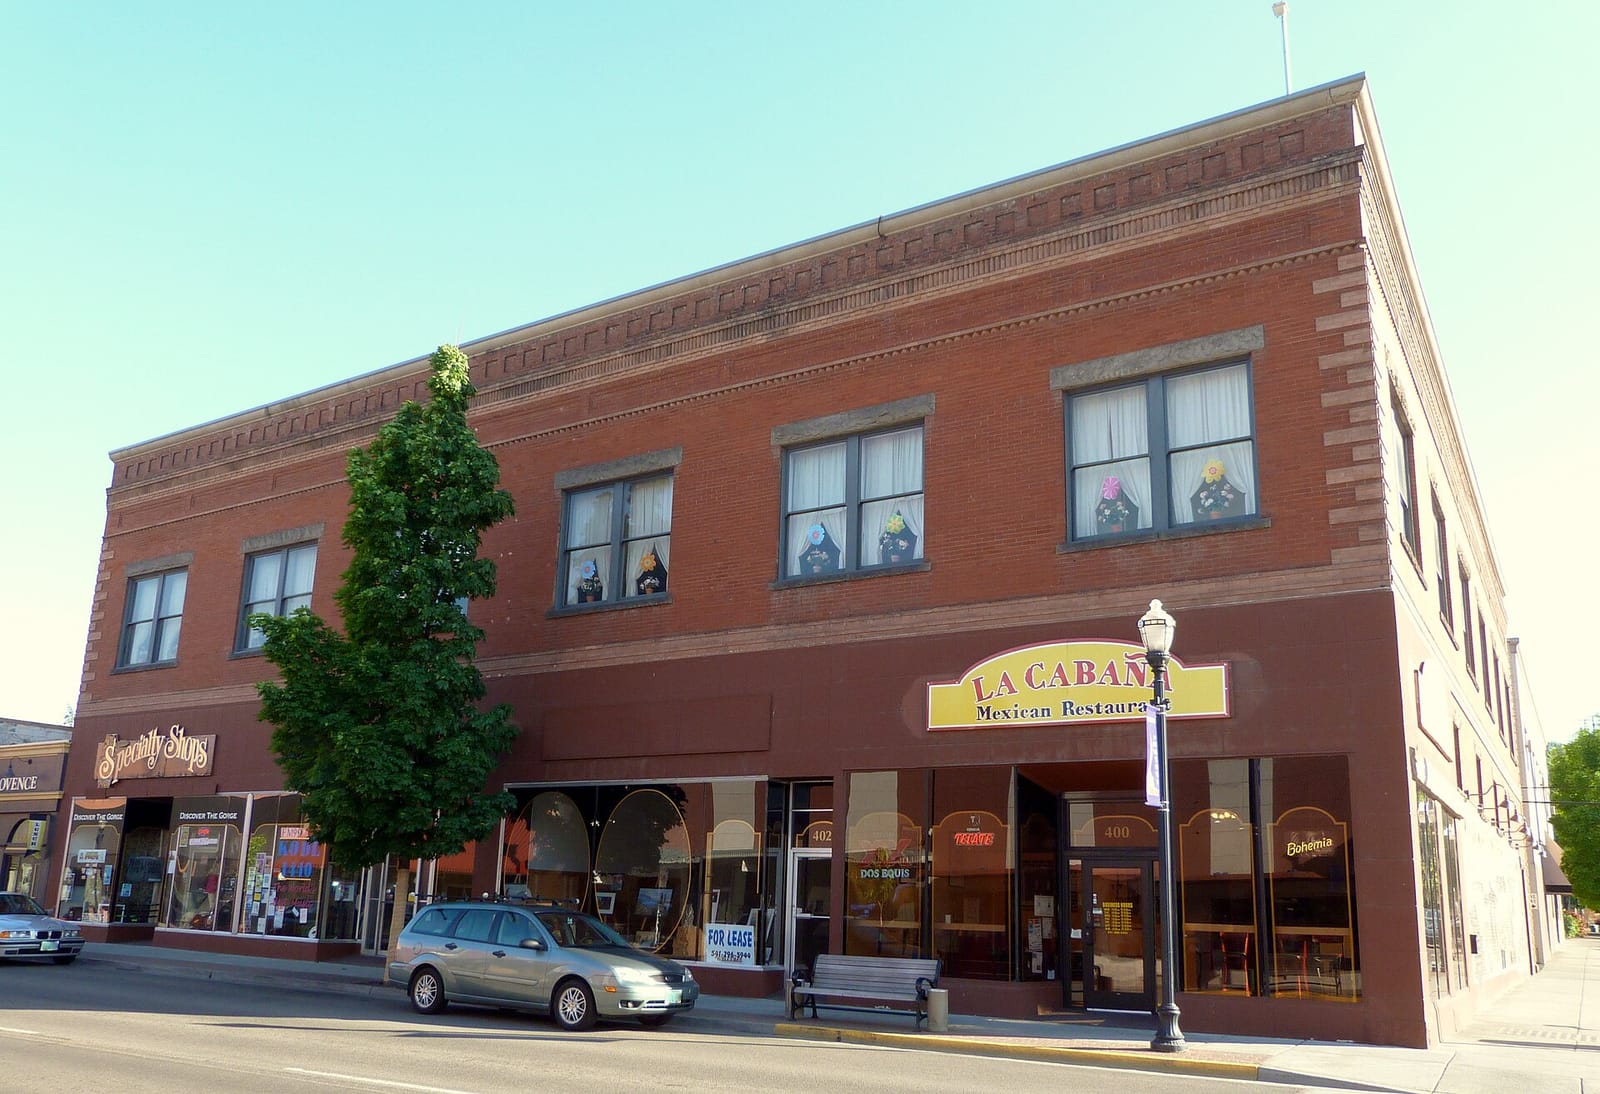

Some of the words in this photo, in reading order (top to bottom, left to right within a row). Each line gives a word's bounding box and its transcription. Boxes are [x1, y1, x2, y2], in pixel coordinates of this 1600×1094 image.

[972, 672, 1018, 703] LA
[976, 704, 1051, 721] Mexican
[1062, 700, 1172, 717] Restaurat
[99, 727, 165, 784] Specialty
[164, 724, 208, 773] Shops
[96, 813, 106, 821] THE
[180, 811, 206, 820] DISCOVER
[206, 811, 219, 820] THE
[219, 811, 238, 820] GORGE
[812, 830, 832, 841] 402
[954, 832, 994, 846] TECATE
[1105, 826, 1129, 838] 400
[1287, 837, 1333, 857] Bohemia
[860, 868, 880, 879] DOS
[881, 868, 910, 879] EQUIS
[708, 929, 725, 946] FOR
[727, 930, 752, 947] LEASE
